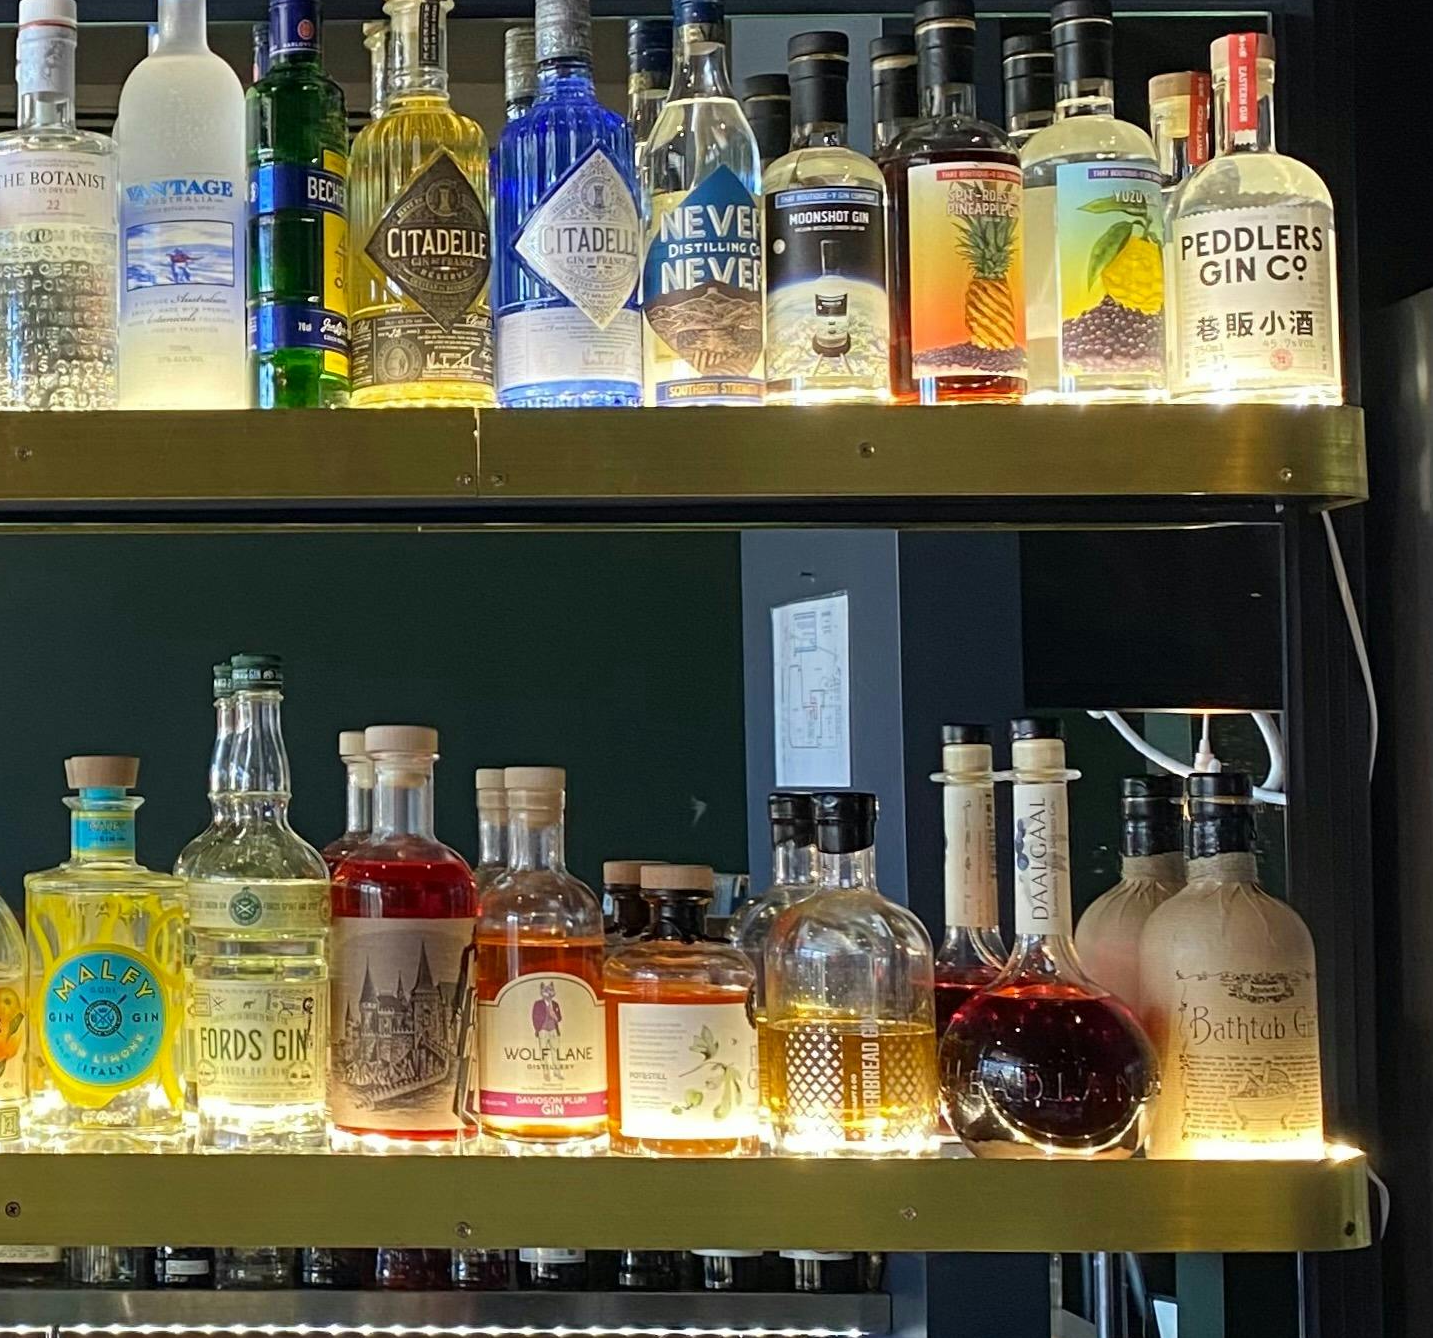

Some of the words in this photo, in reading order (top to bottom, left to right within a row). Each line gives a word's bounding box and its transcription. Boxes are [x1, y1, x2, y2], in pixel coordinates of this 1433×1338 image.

[30, 171, 106, 189] BOTANIST
[126, 179, 233, 199] VANTAGE
[46, 200, 60, 210] 22
[789, 211, 850, 226] MOONSHOT
[852, 211, 869, 224] GIN
[387, 228, 487, 259] CITADELLE
[542, 226, 637, 256] CITADELLE
[1181, 224, 1323, 261] PEDDLERS
[668, 243, 746, 258] DISTILLING
[411, 257, 430, 266] GIN
[441, 258, 475, 267] FRANCE
[566, 256, 584, 264] GIN
[597, 255, 627, 265] FRANCE
[1199, 257, 1256, 286] GIN
[1029, 798, 1048, 920] DAALGAAL
[54, 959, 156, 1003] MALFY
[48, 1012, 75, 1023] GIN
[132, 1012, 159, 1023] GIN
[1190, 1006, 1285, 1045] Bathtub
[200, 1027, 261, 1062] FORDS
[273, 1028, 308, 1062] GIN
[503, 1047, 551, 1061] WOLF
[556, 1047, 593, 1061] LANE
[515, 1095, 562, 1104] DAVIDSON
[564, 1096, 587, 1104] PLUM
[541, 1103, 564, 1115] GIN
